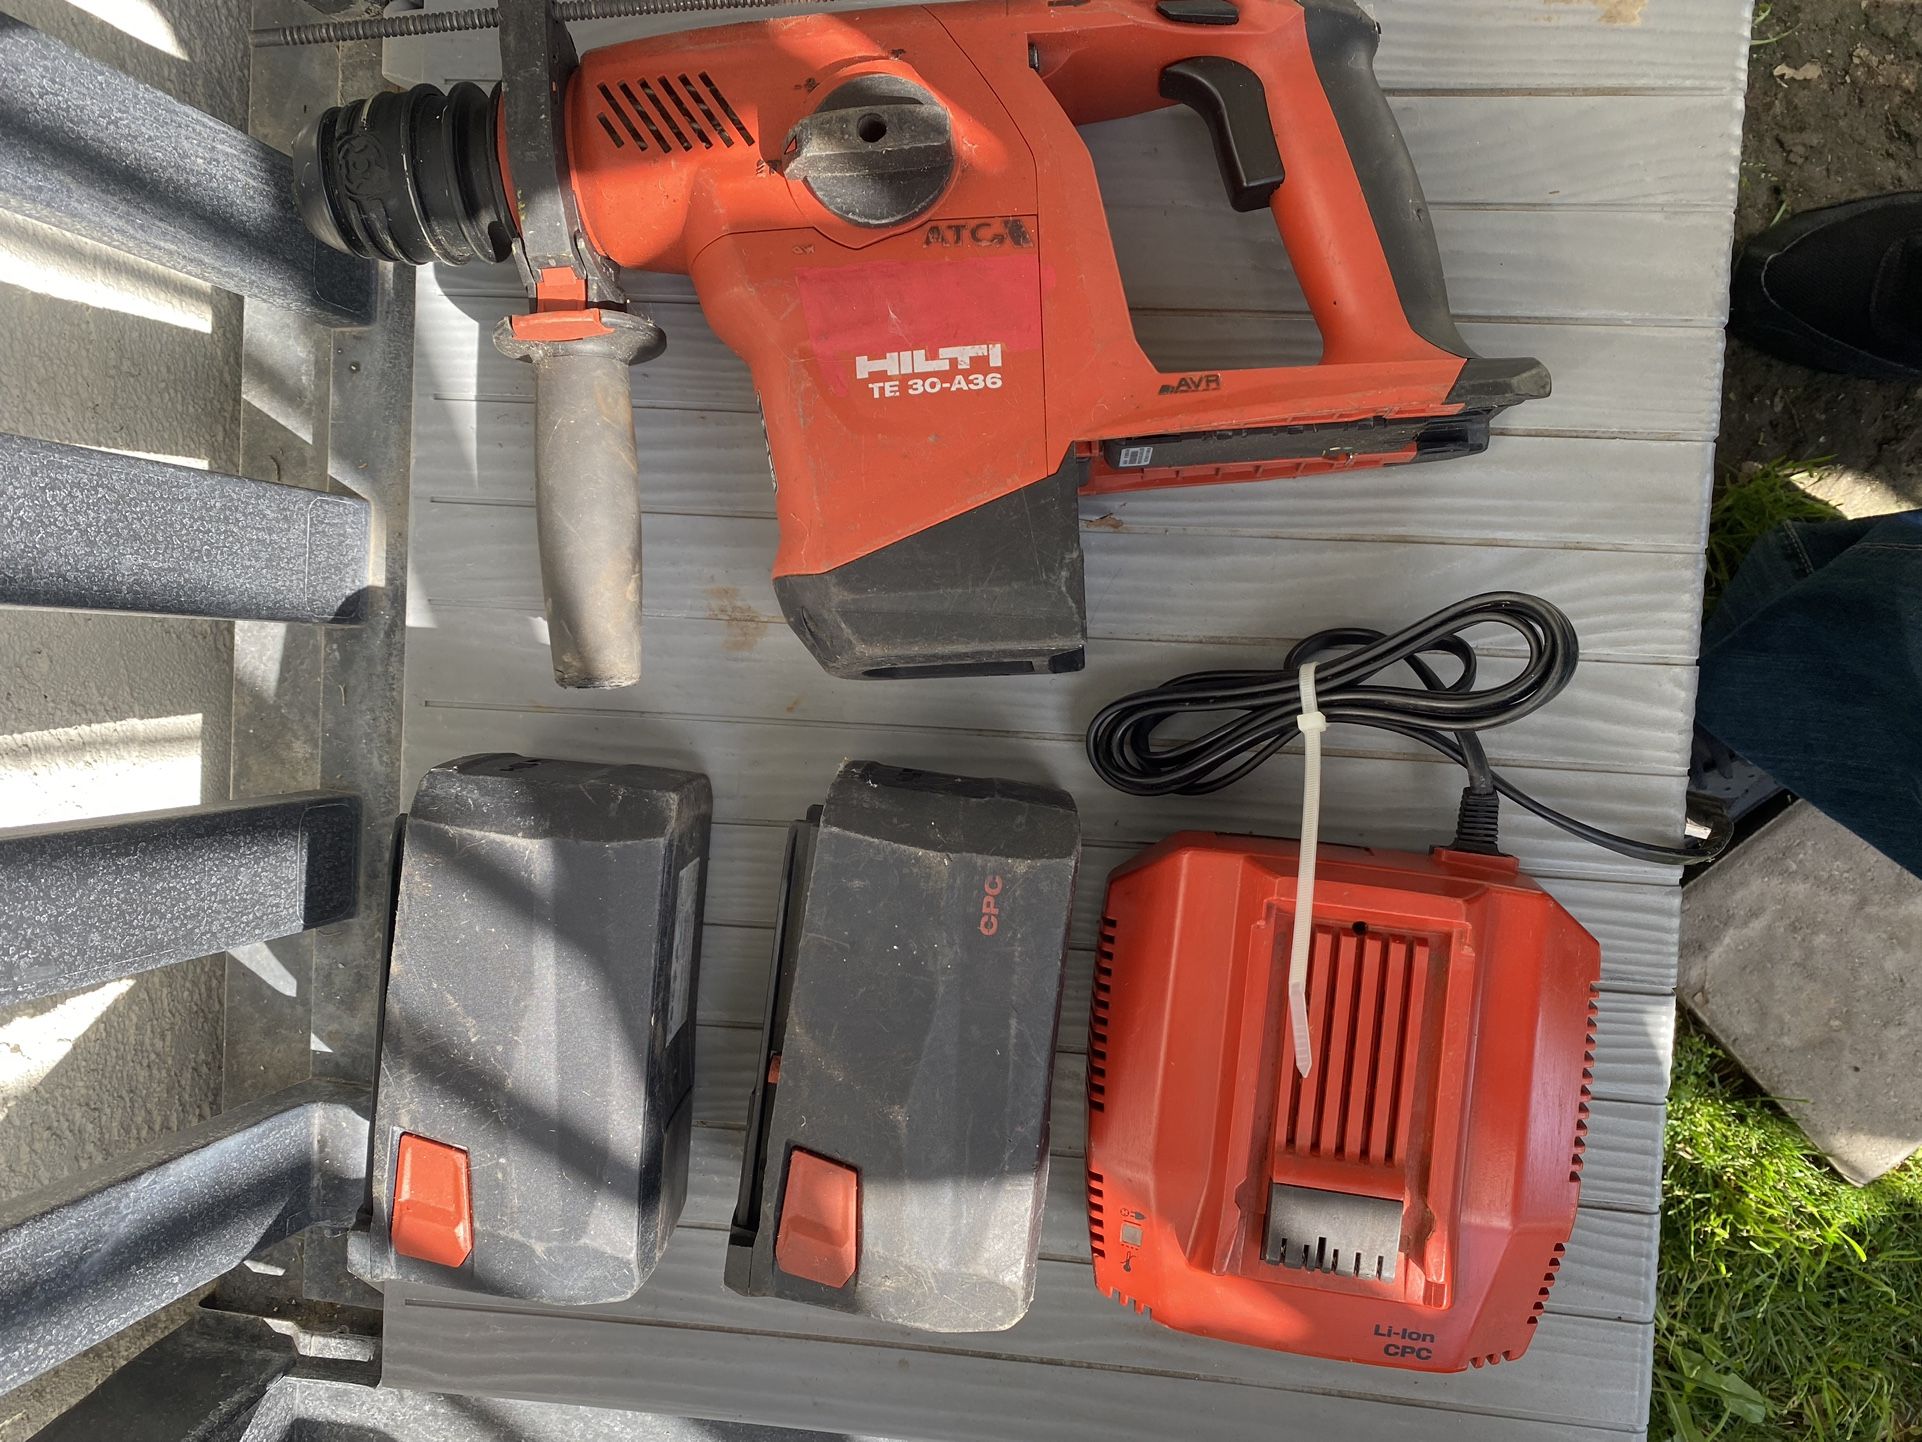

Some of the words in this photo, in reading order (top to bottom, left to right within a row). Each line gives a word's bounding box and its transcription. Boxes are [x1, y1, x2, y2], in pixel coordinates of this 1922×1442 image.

[855, 343, 1002, 379] HILTI
[868, 381, 900, 398] TE
[907, 373, 1003, 395] 30-A36
[1174, 374, 1220, 392] AVR
[980, 874, 1003, 936] CPC
[1373, 1323, 1436, 1344] Li-Ion
[1383, 1343, 1433, 1361] CPC
